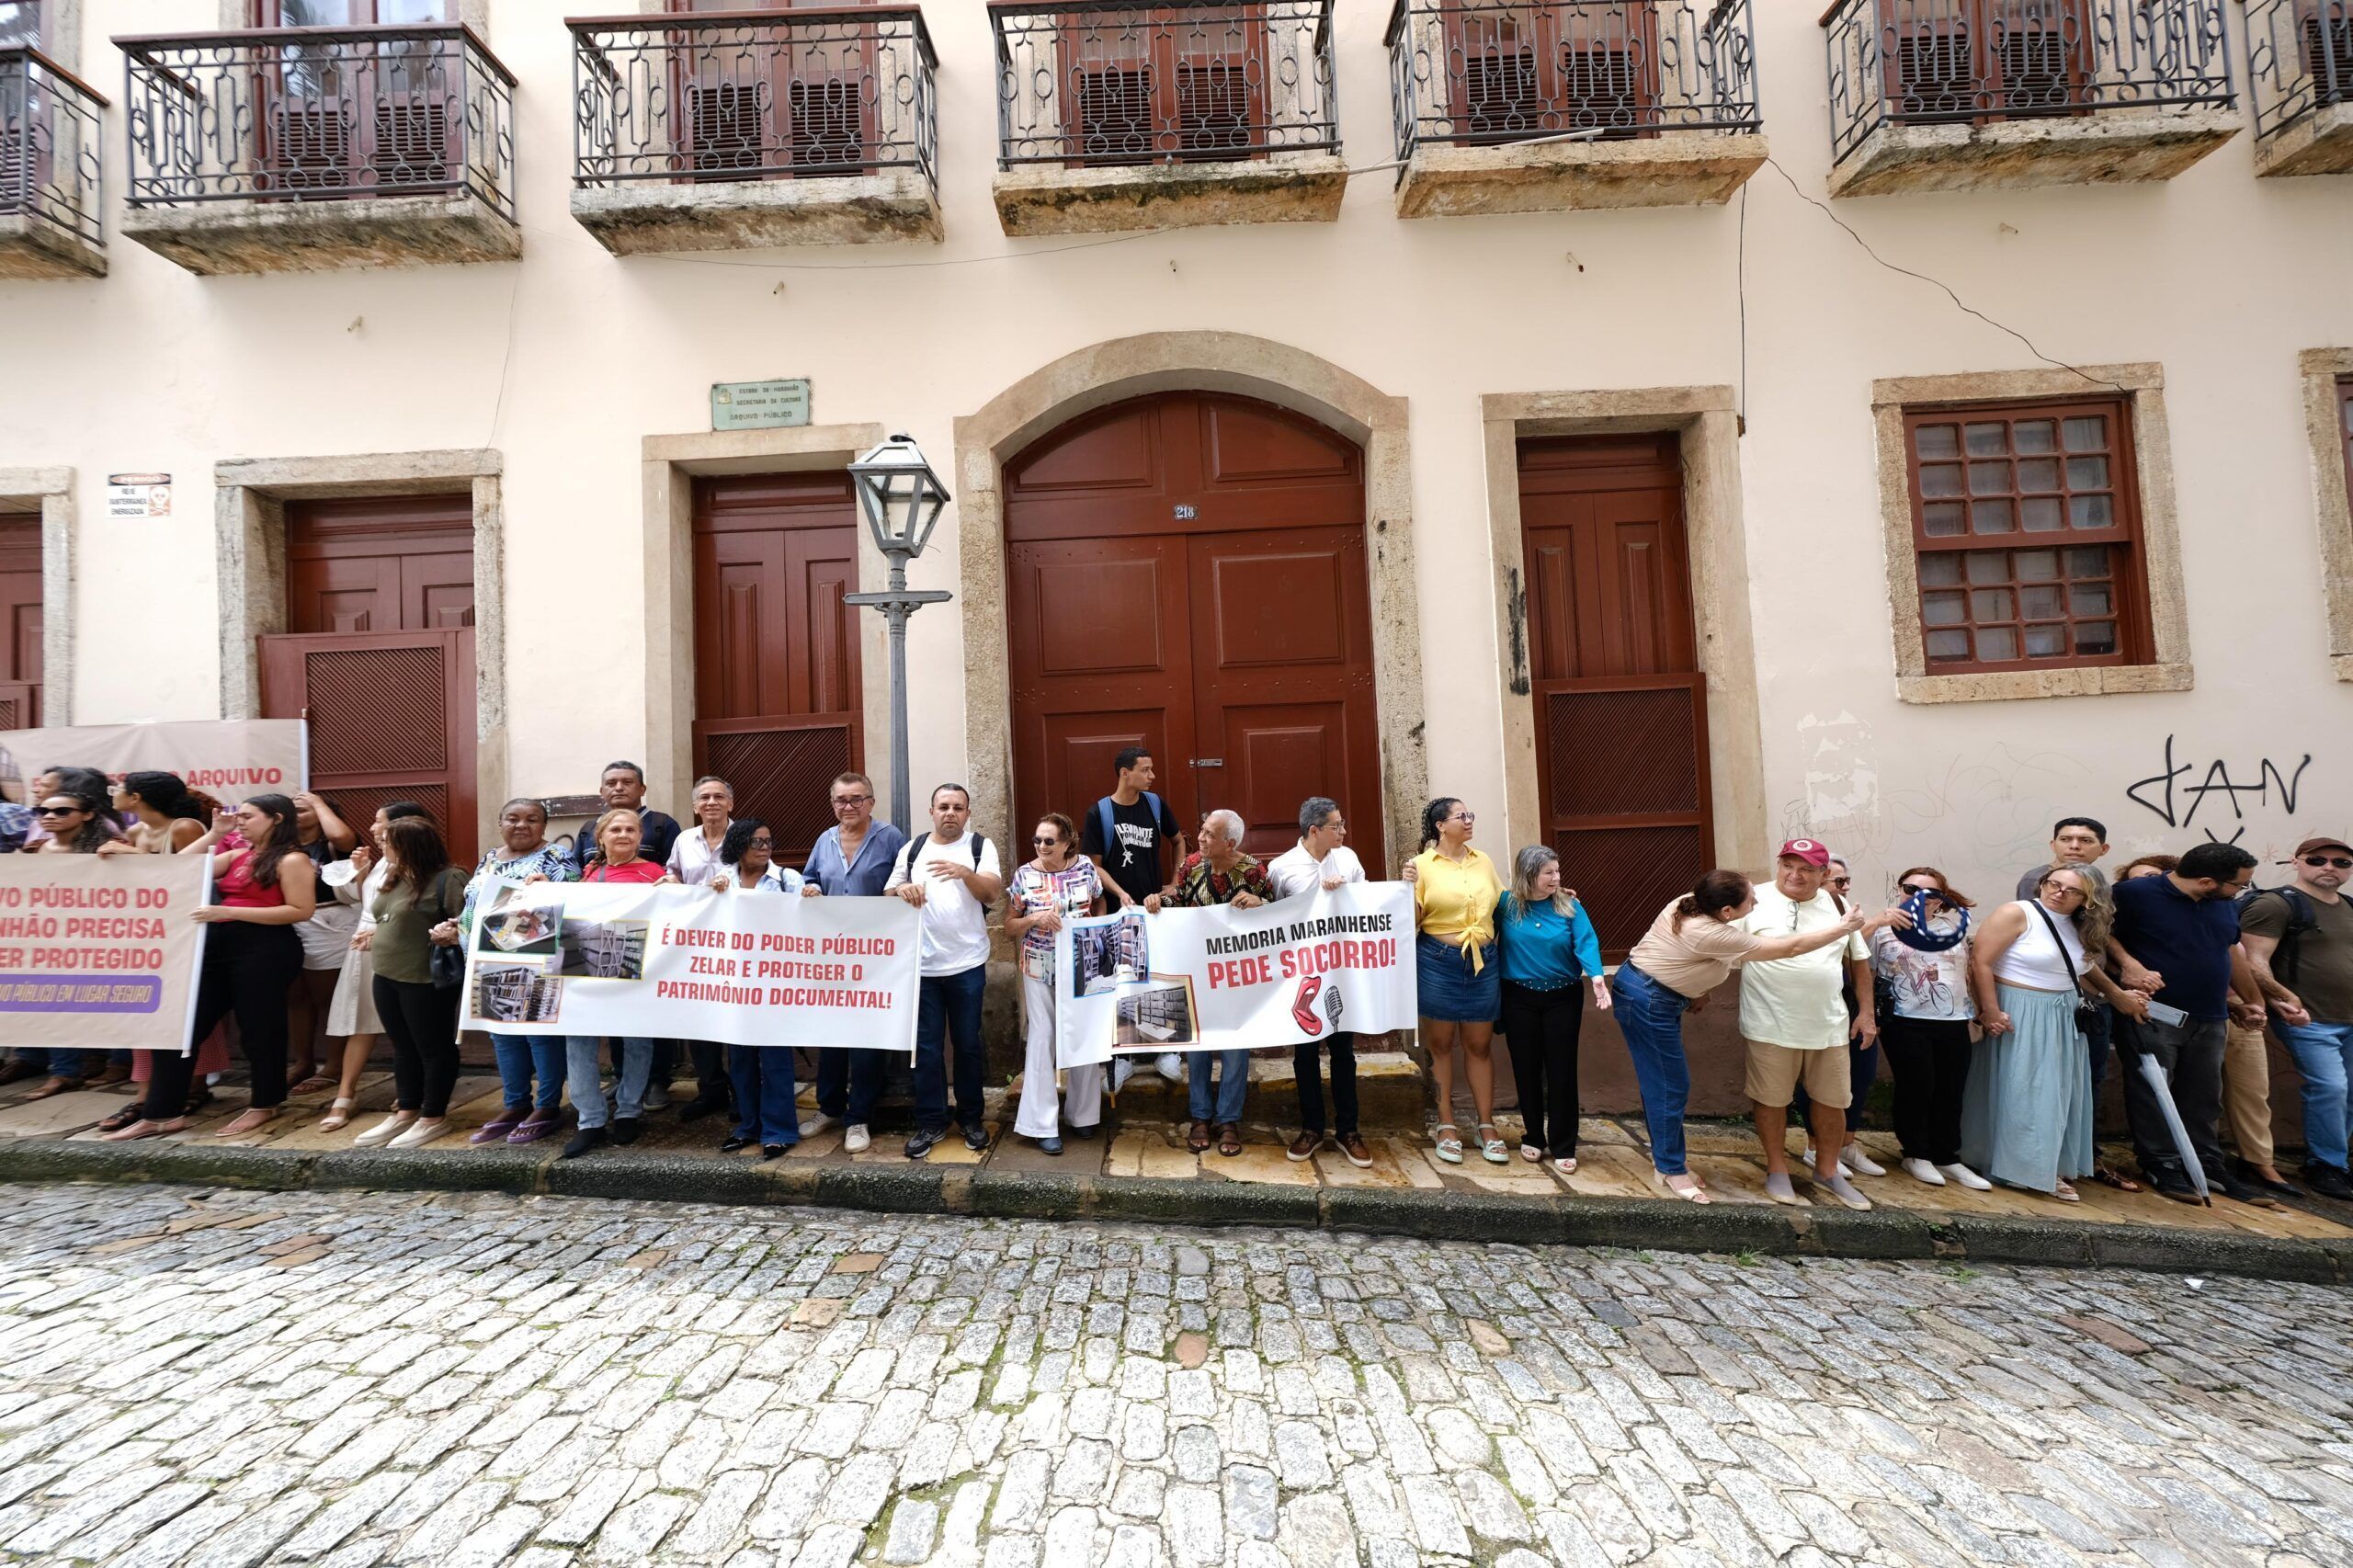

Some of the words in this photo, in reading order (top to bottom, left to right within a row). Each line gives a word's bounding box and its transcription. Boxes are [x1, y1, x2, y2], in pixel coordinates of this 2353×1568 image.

[730, 413, 758, 421] ARQUIVO
[763, 410, 792, 419] PÚBLICO
[1176, 506, 1194, 518] 218
[187, 767, 281, 788] ARQUIVO
[1116, 824, 1154, 838] LEVANTE
[28, 882, 128, 908] PÚBLICO
[135, 888, 168, 908] DO
[65, 917, 165, 938] PRECISA
[1206, 926, 1287, 955] MEMORIA
[1290, 914, 1392, 941] MARANHENSE
[661, 922, 671, 945] É
[675, 928, 726, 949] DEVER
[731, 932, 754, 950] DO
[760, 934, 814, 954] PODER
[822, 932, 895, 956] PÚBLICO
[30, 948, 163, 970] PROTEGIDO
[689, 956, 736, 976] ZELAR
[742, 960, 752, 977] E
[757, 960, 845, 981] PROTEGER
[851, 964, 863, 981] O
[1208, 954, 1273, 989] PEDE
[1279, 937, 1396, 979] SOCORRO!
[11, 981, 57, 1002] PÚBLICO
[56, 984, 74, 1003] EM
[74, 984, 110, 1003] LUGAR
[109, 984, 153, 1003] SEGURO
[656, 980, 763, 1006] PATRIMÔNIO
[768, 987, 892, 1009] DOCUMENTAL!
